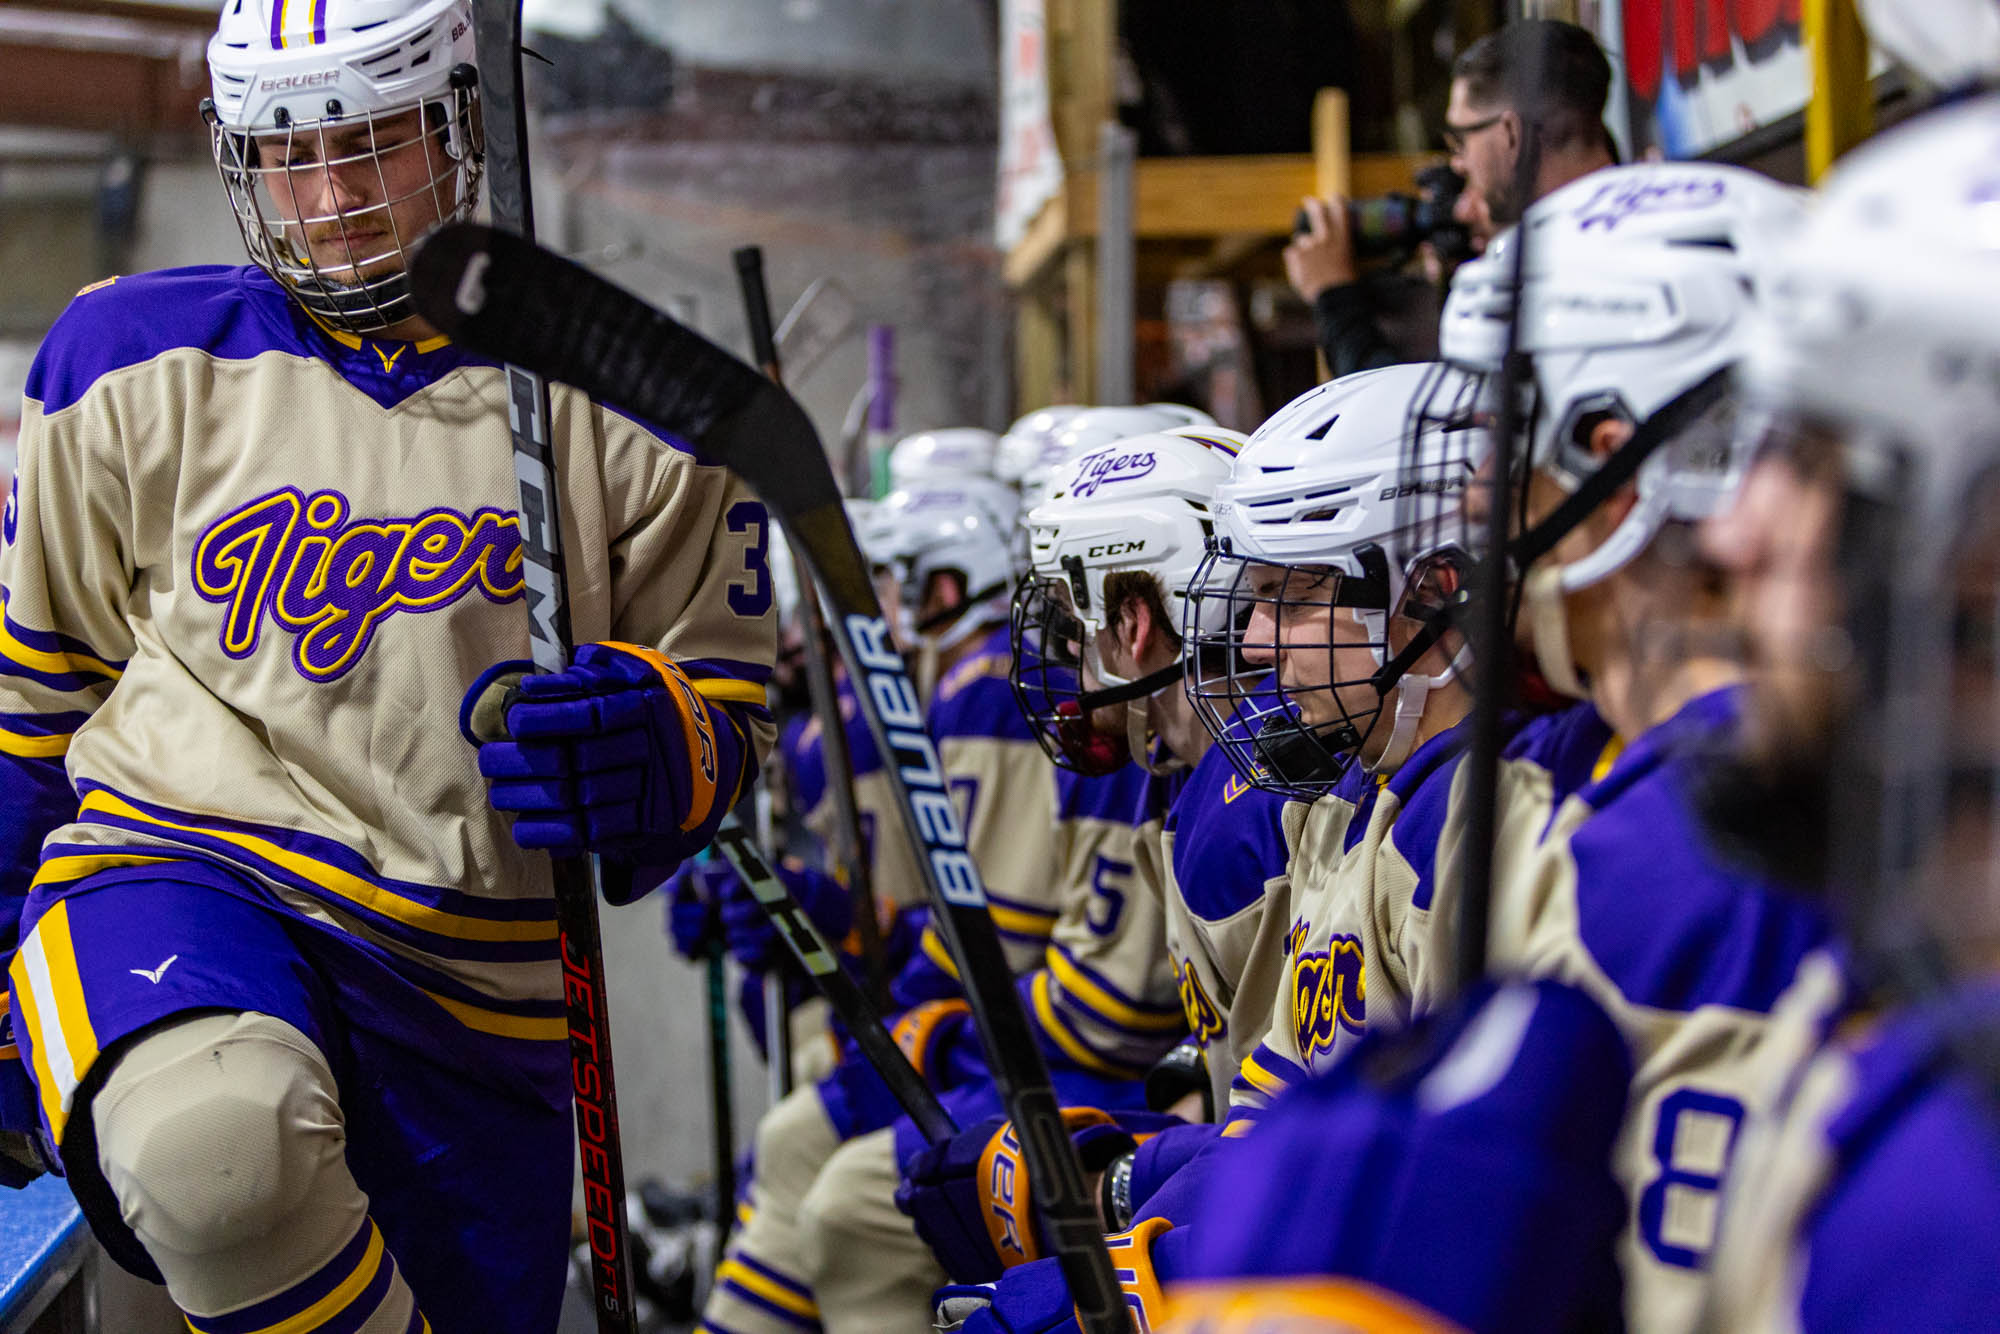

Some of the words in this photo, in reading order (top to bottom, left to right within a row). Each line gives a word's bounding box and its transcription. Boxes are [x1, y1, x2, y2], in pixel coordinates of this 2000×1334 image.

[261, 69, 340, 92] BAUER
[1069, 447, 1157, 498] Tigers
[191, 486, 526, 682] Tiger
[725, 500, 770, 617] 3
[1088, 540, 1146, 558] CCM
[845, 612, 989, 908] BAUER
[1085, 853, 1134, 937] 5
[561, 930, 617, 1261] JETSPEED
[1638, 1087, 1746, 1270] 8
